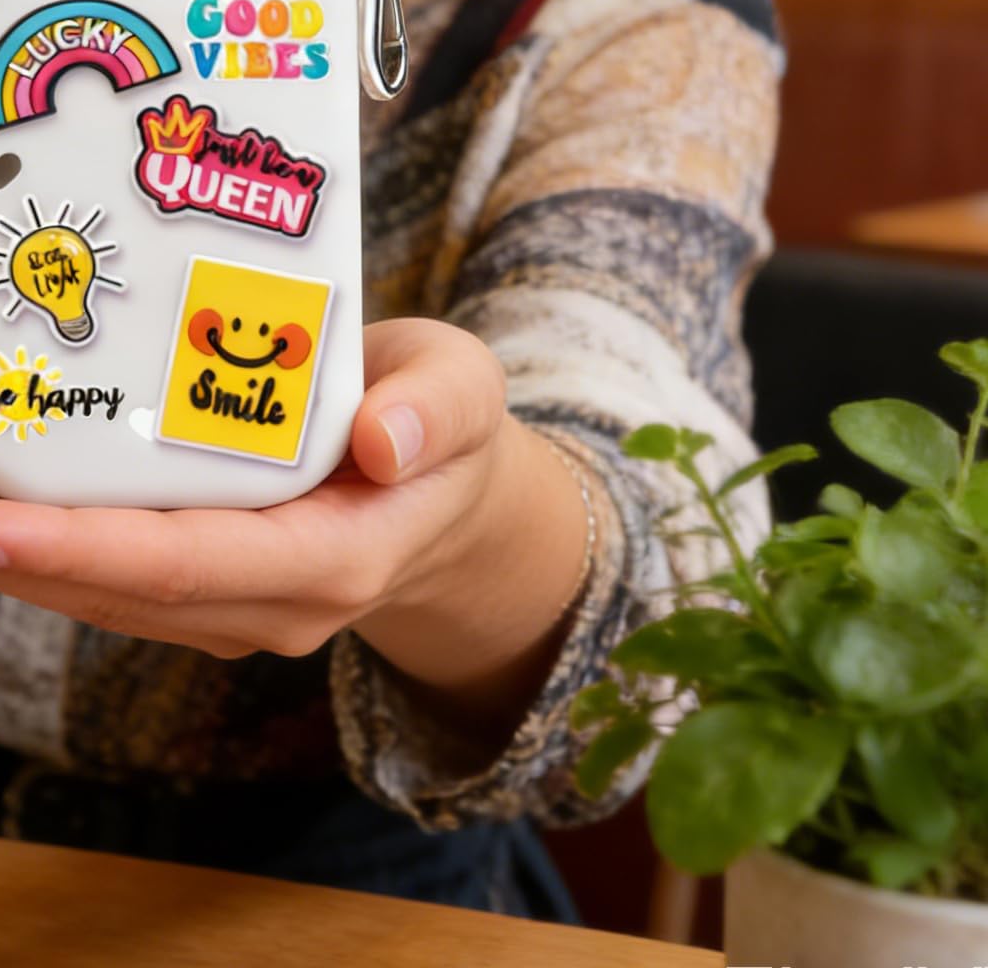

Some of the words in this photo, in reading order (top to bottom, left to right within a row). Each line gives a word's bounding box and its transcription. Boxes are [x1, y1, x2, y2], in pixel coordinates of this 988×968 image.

[8, 17, 133, 80] LUCKY
[189, 41, 330, 80] VIBES
[146, 152, 308, 230] QUEEN
[28, 373, 125, 421] happy
[189, 368, 286, 425] Smile
